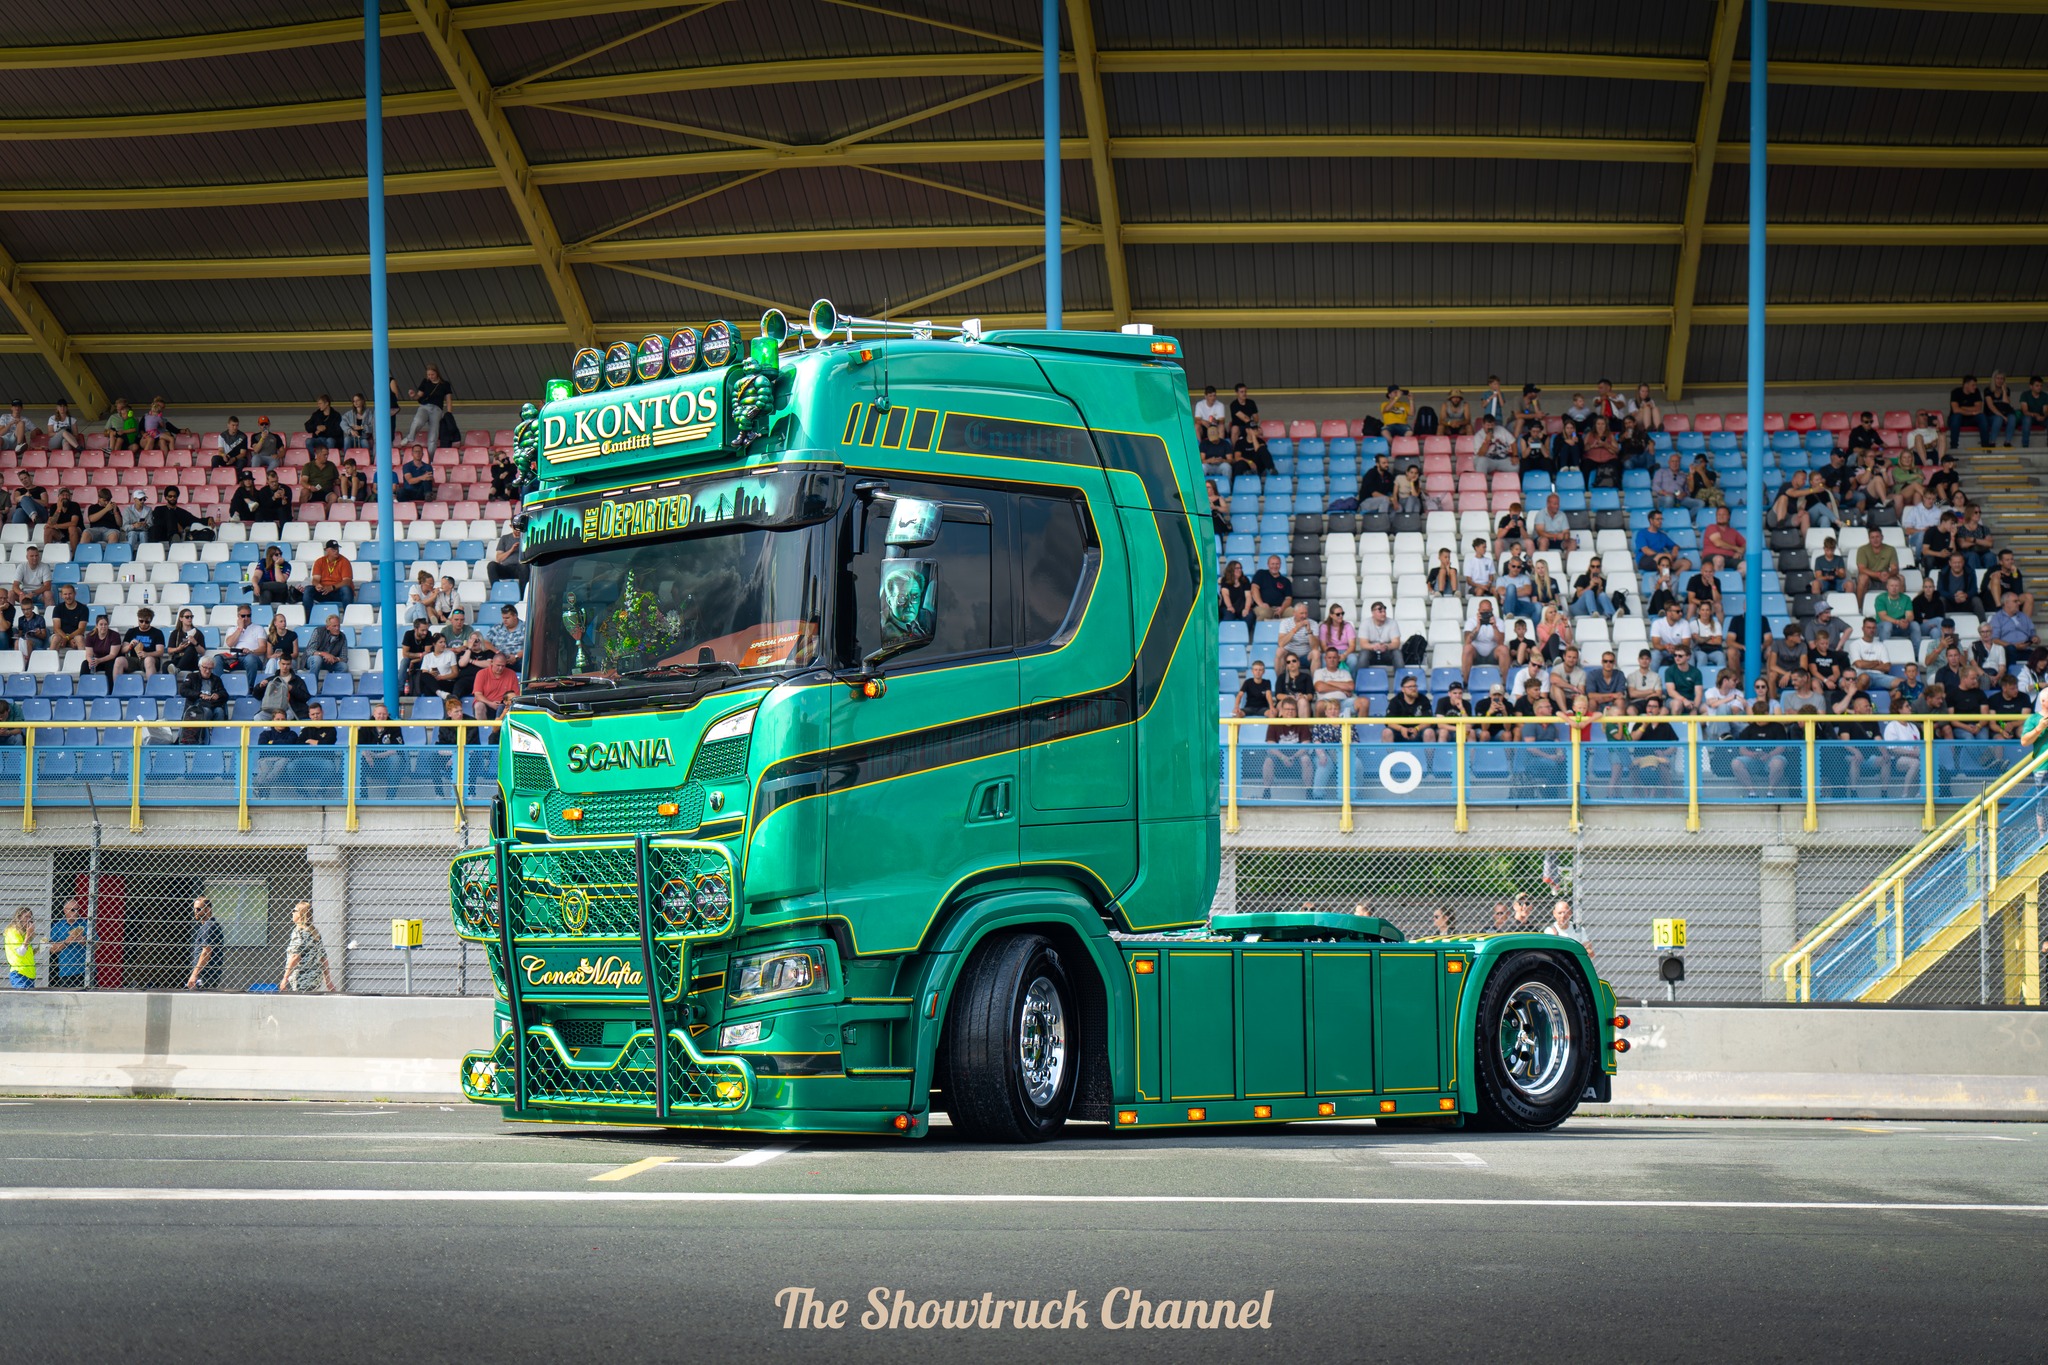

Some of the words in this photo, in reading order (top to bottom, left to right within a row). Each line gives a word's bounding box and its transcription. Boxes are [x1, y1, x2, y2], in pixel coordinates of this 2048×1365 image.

[543, 386, 718, 450] D.KONTOS
[601, 433, 651, 455] Contlift
[583, 507, 600, 543] THE
[749, 639, 777, 650] SPECIAL
[778, 634, 800, 644] PAINT
[567, 737, 676, 773] SCANIA
[395, 924, 405, 944] 17
[410, 923, 420, 944] 17
[1657, 924, 1669, 944] 15
[1674, 924, 1685, 944] 15
